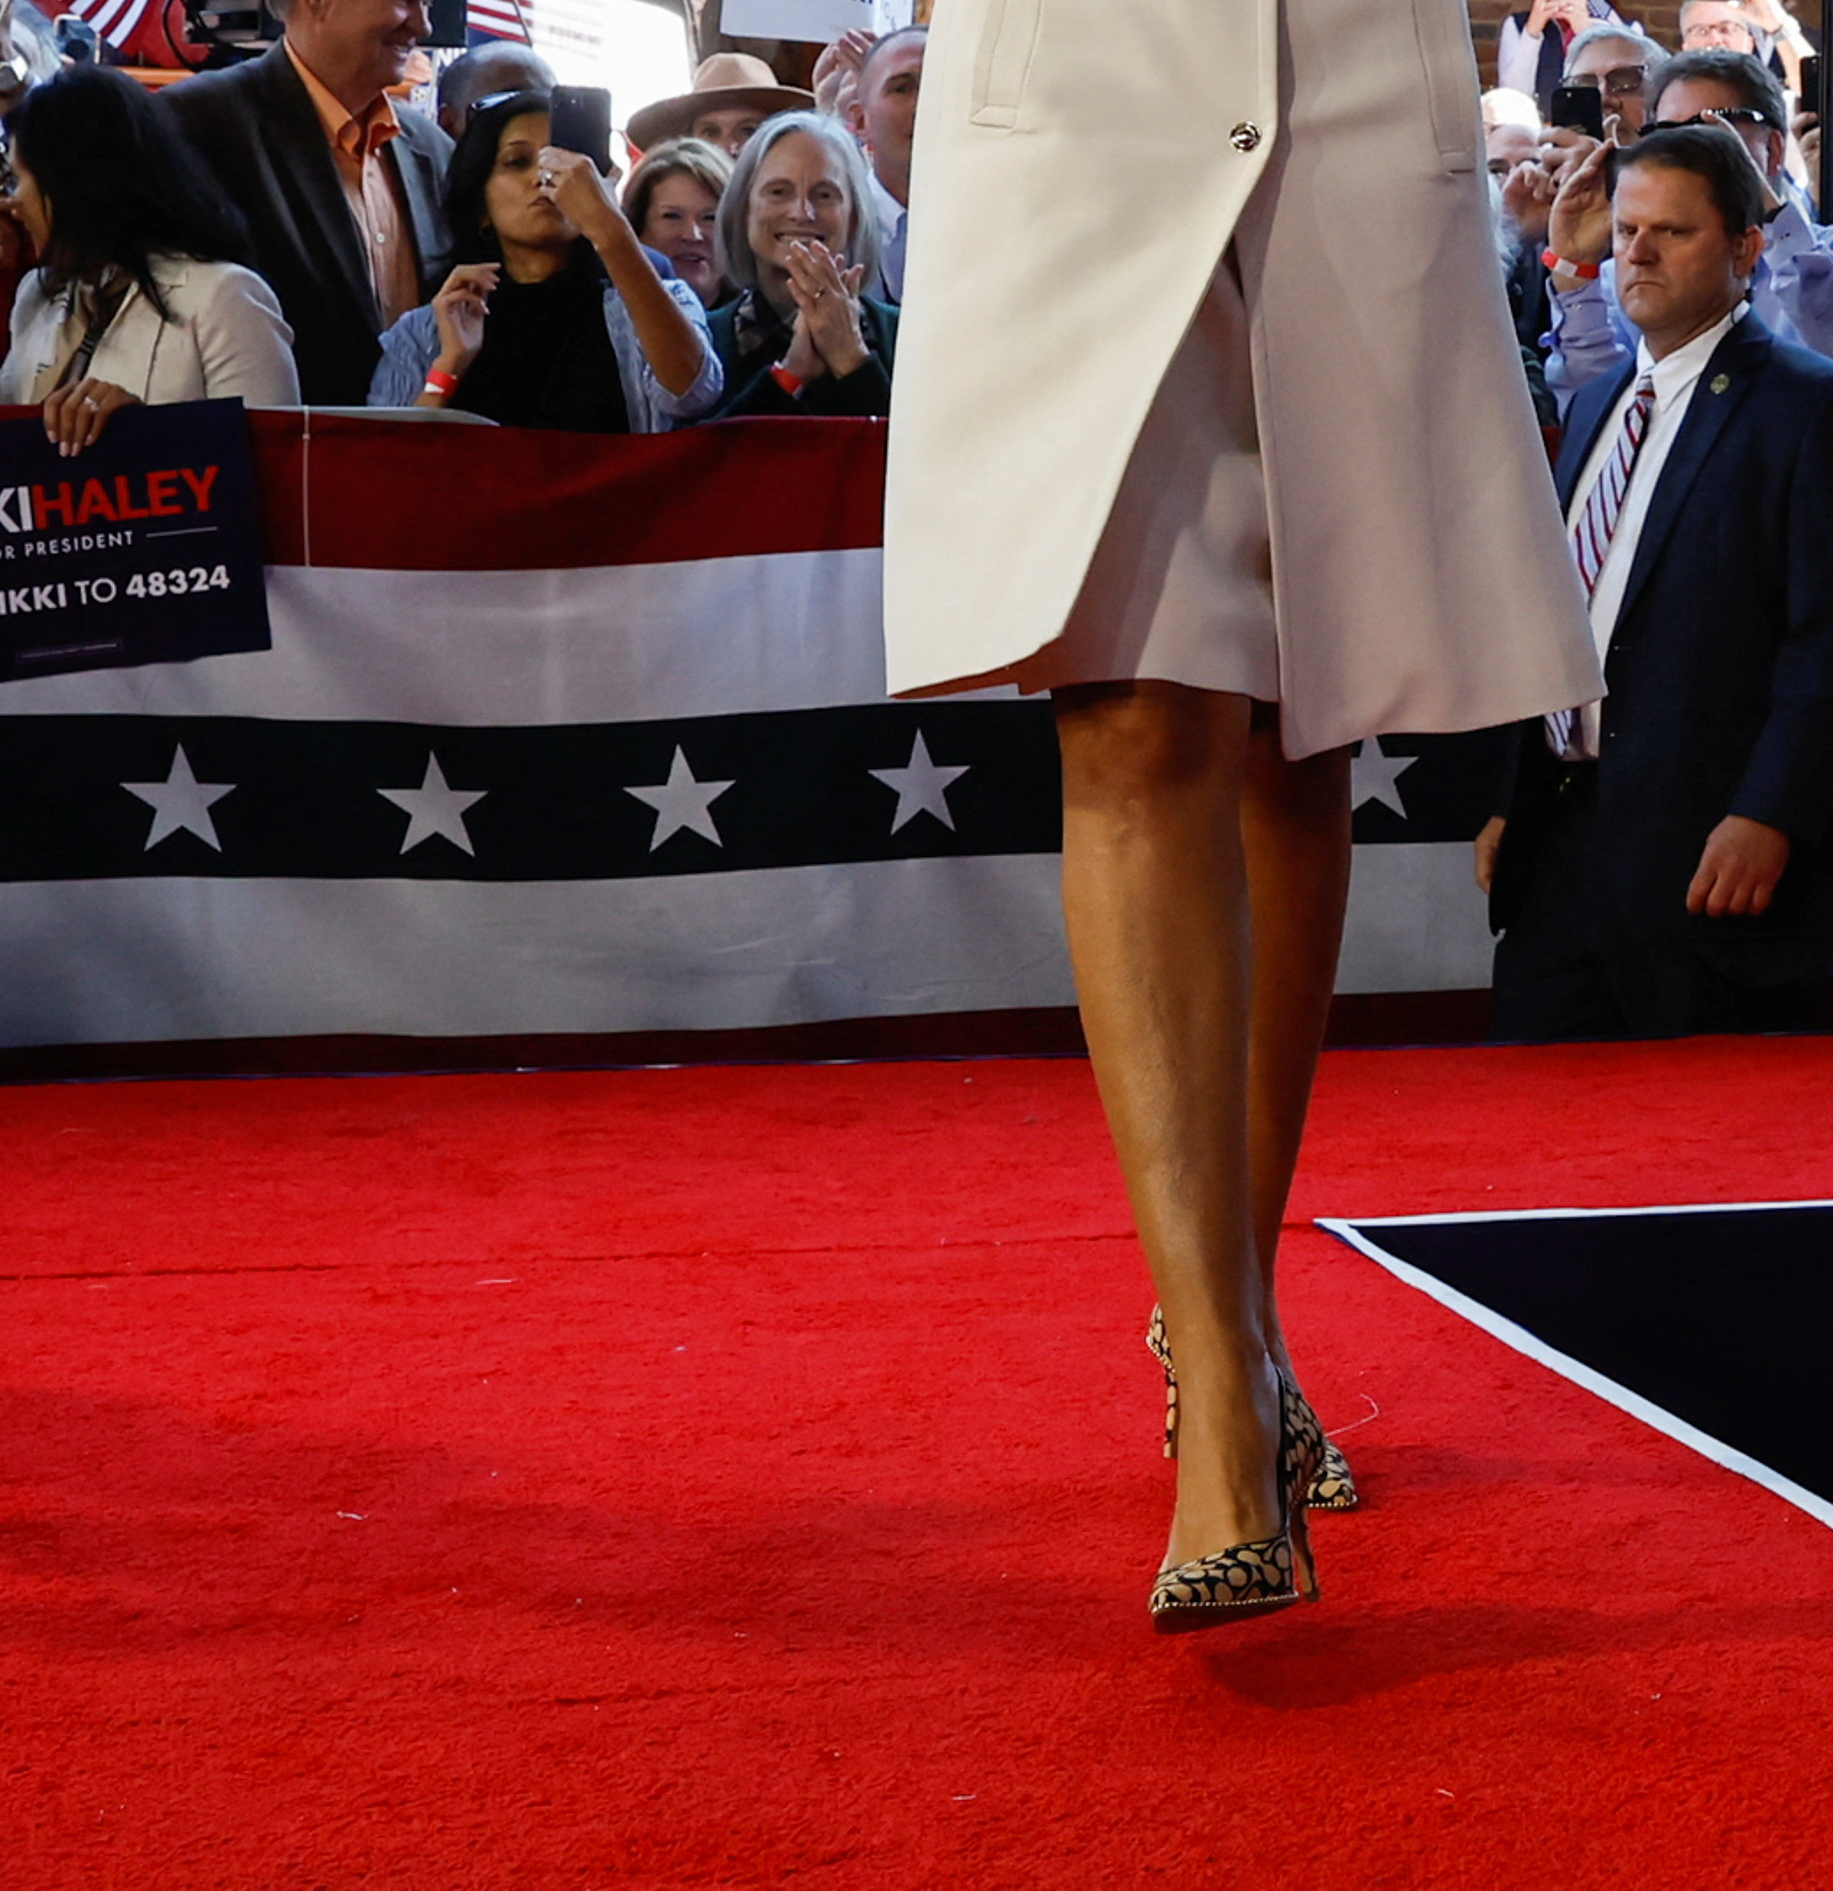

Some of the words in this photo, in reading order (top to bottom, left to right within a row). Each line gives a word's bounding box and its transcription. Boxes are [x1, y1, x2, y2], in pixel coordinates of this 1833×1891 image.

[25, 531, 134, 557] PRESIDENT
[74, 578, 116, 605] TO
[126, 565, 230, 598] 48324
